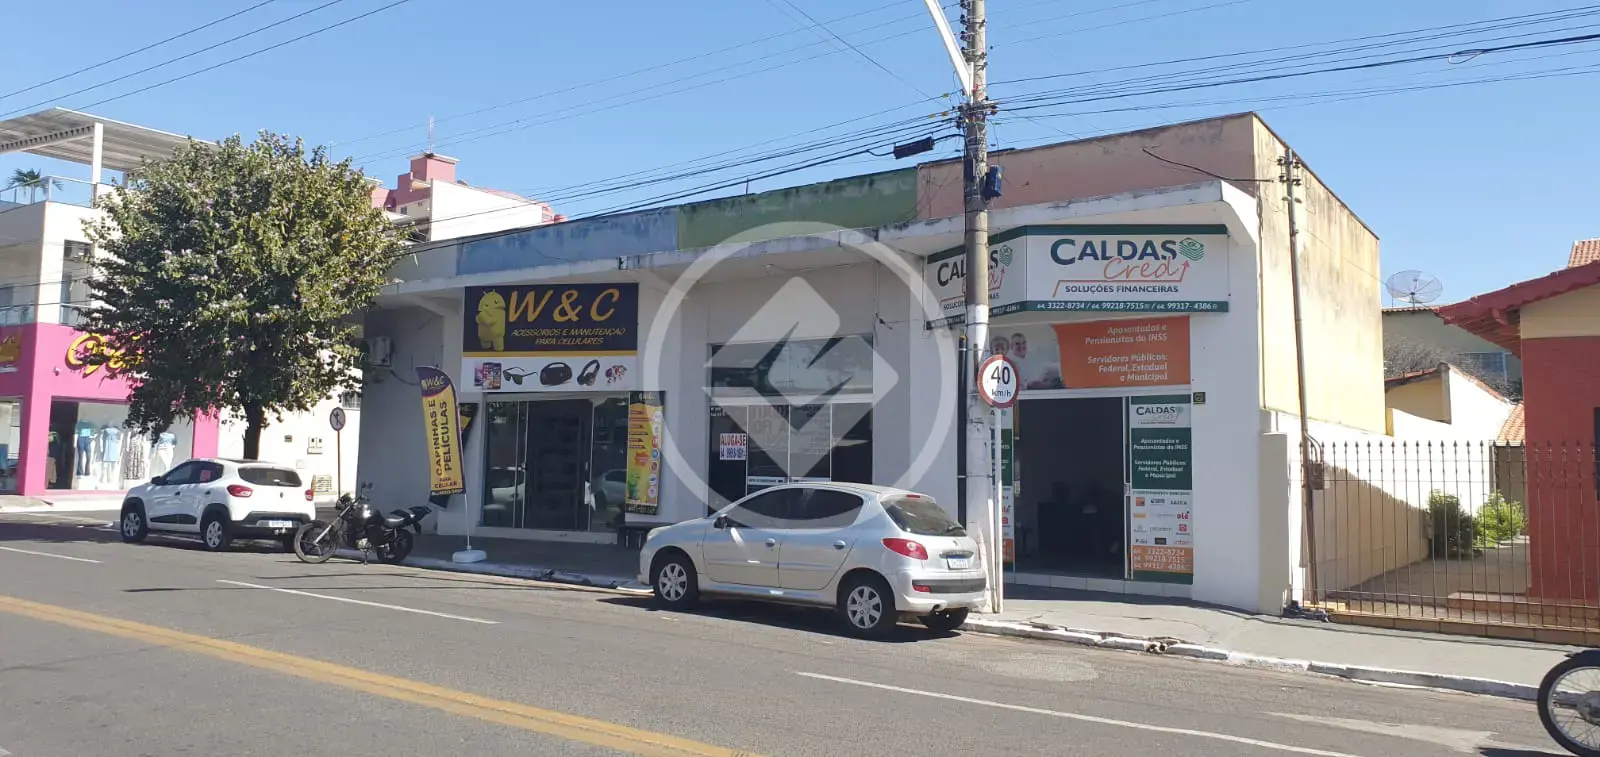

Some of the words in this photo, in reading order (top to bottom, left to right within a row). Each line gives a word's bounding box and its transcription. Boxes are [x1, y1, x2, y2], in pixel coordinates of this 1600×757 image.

[1050, 238, 1177, 265] CALDAS
[937, 250, 998, 287] CALS
[1103, 256, 1180, 280] Cred
[1065, 284, 1114, 294] SOLUÇÕES
[1116, 284, 1179, 293] FINANCEIRAS
[508, 288, 553, 323] W
[553, 289, 583, 323] &
[590, 288, 620, 322] C
[1107, 324, 1159, 335] Aposentados
[558, 337, 604, 345] CELULARES
[1085, 335, 1134, 345] Pensionistas
[1148, 333, 1167, 342] INSS
[1087, 355, 1129, 364] Servidores
[1098, 364, 1130, 373] Federal,
[1132, 362, 1168, 371] Estadual
[991, 366, 1011, 385] 40
[1127, 372, 1168, 383] Municipal
[991, 389, 1012, 398] km/h
[428, 400, 436, 408] E
[1136, 406, 1176, 415] CALDAS
[440, 401, 452, 471] PELÍCULAS
[720, 434, 746, 446] ALUGA-SE
[430, 409, 443, 476] CAPINHAS
